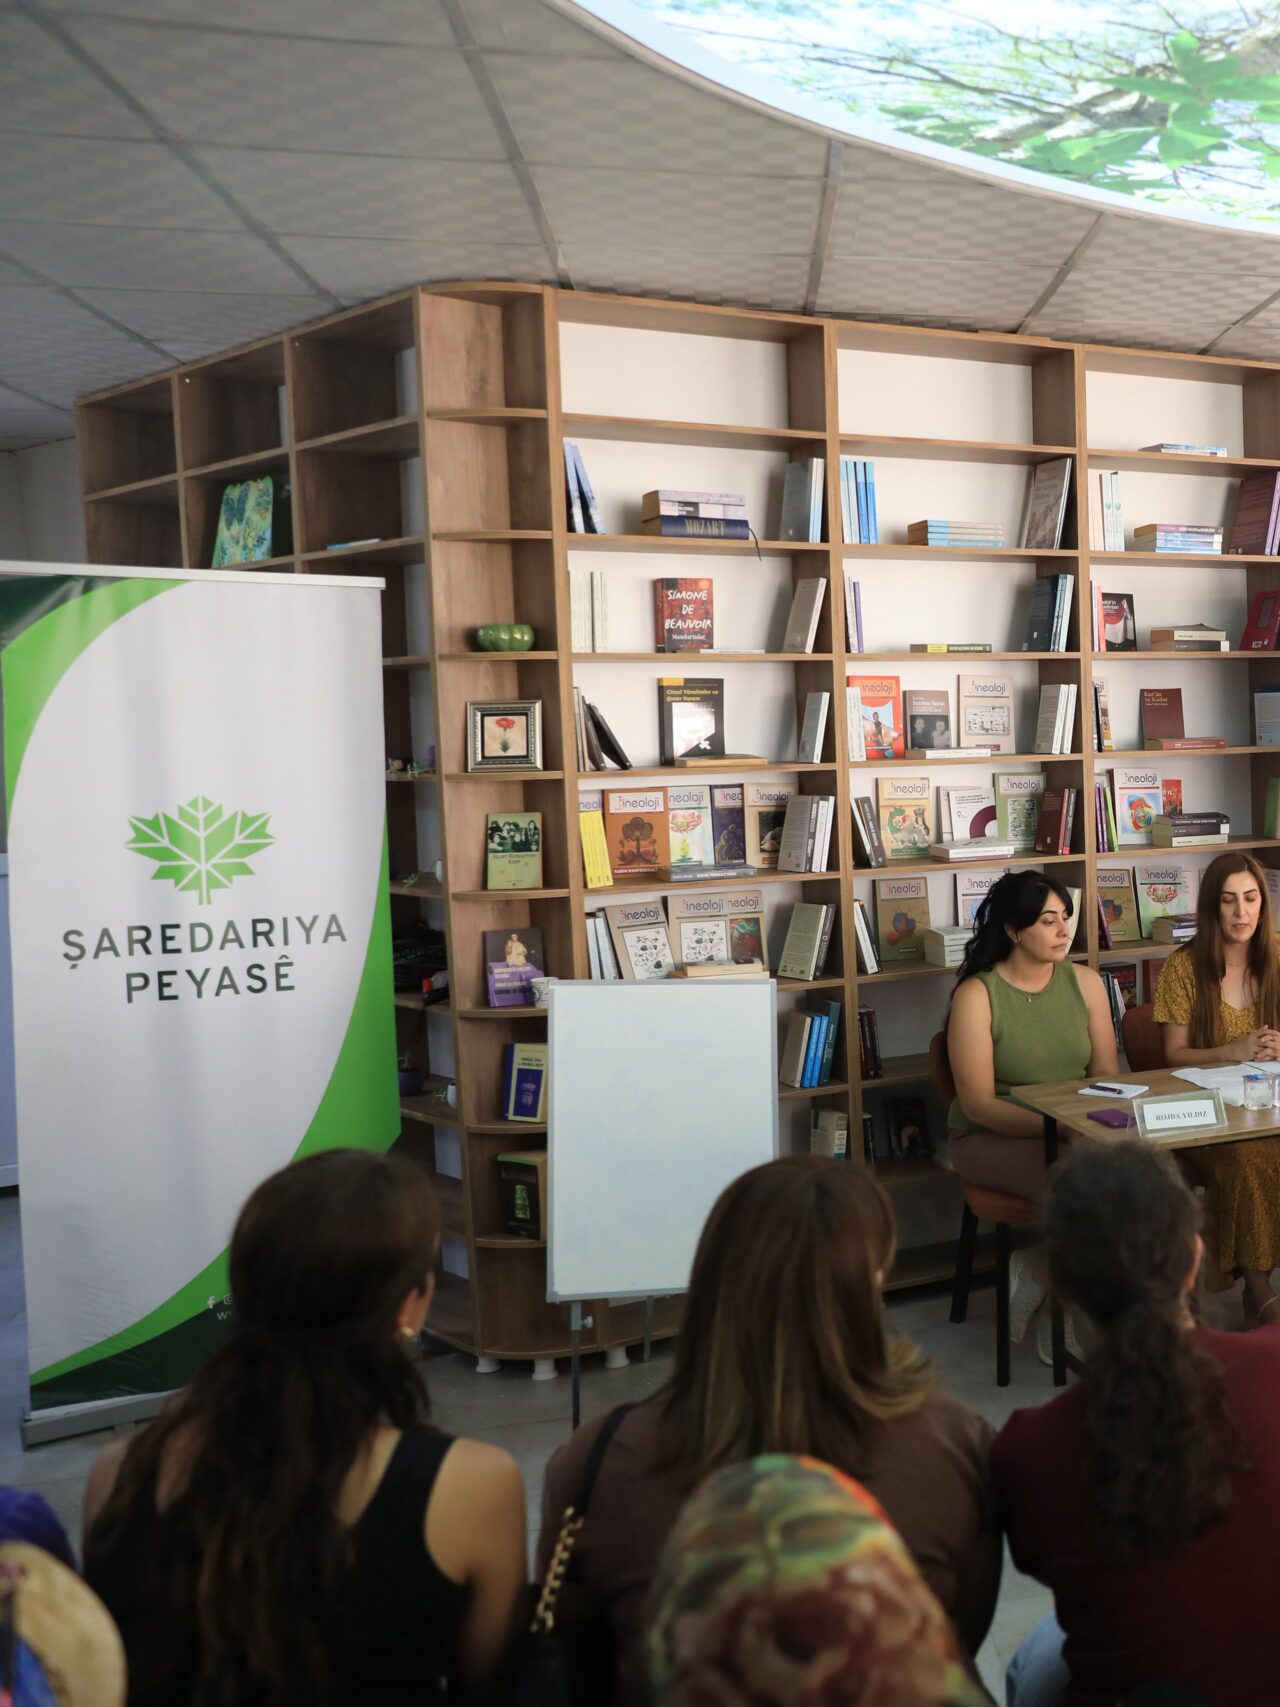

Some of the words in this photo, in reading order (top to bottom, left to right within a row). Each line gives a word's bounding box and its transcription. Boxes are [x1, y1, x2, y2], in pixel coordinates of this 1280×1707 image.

[685, 519, 727, 536] MOZART
[681, 604, 695, 615] DE
[664, 619, 712, 630] BEAUVOIR
[669, 791, 704, 806] neoloji
[1097, 873, 1126, 885] neoloji
[728, 896, 759, 909] neoloji
[62, 913, 347, 970] ŞAREDARIYA
[126, 954, 296, 1004] PEYASÊ
[1155, 1113, 1181, 1121] ROJDA
[1182, 1110, 1208, 1119] YILDIZ
